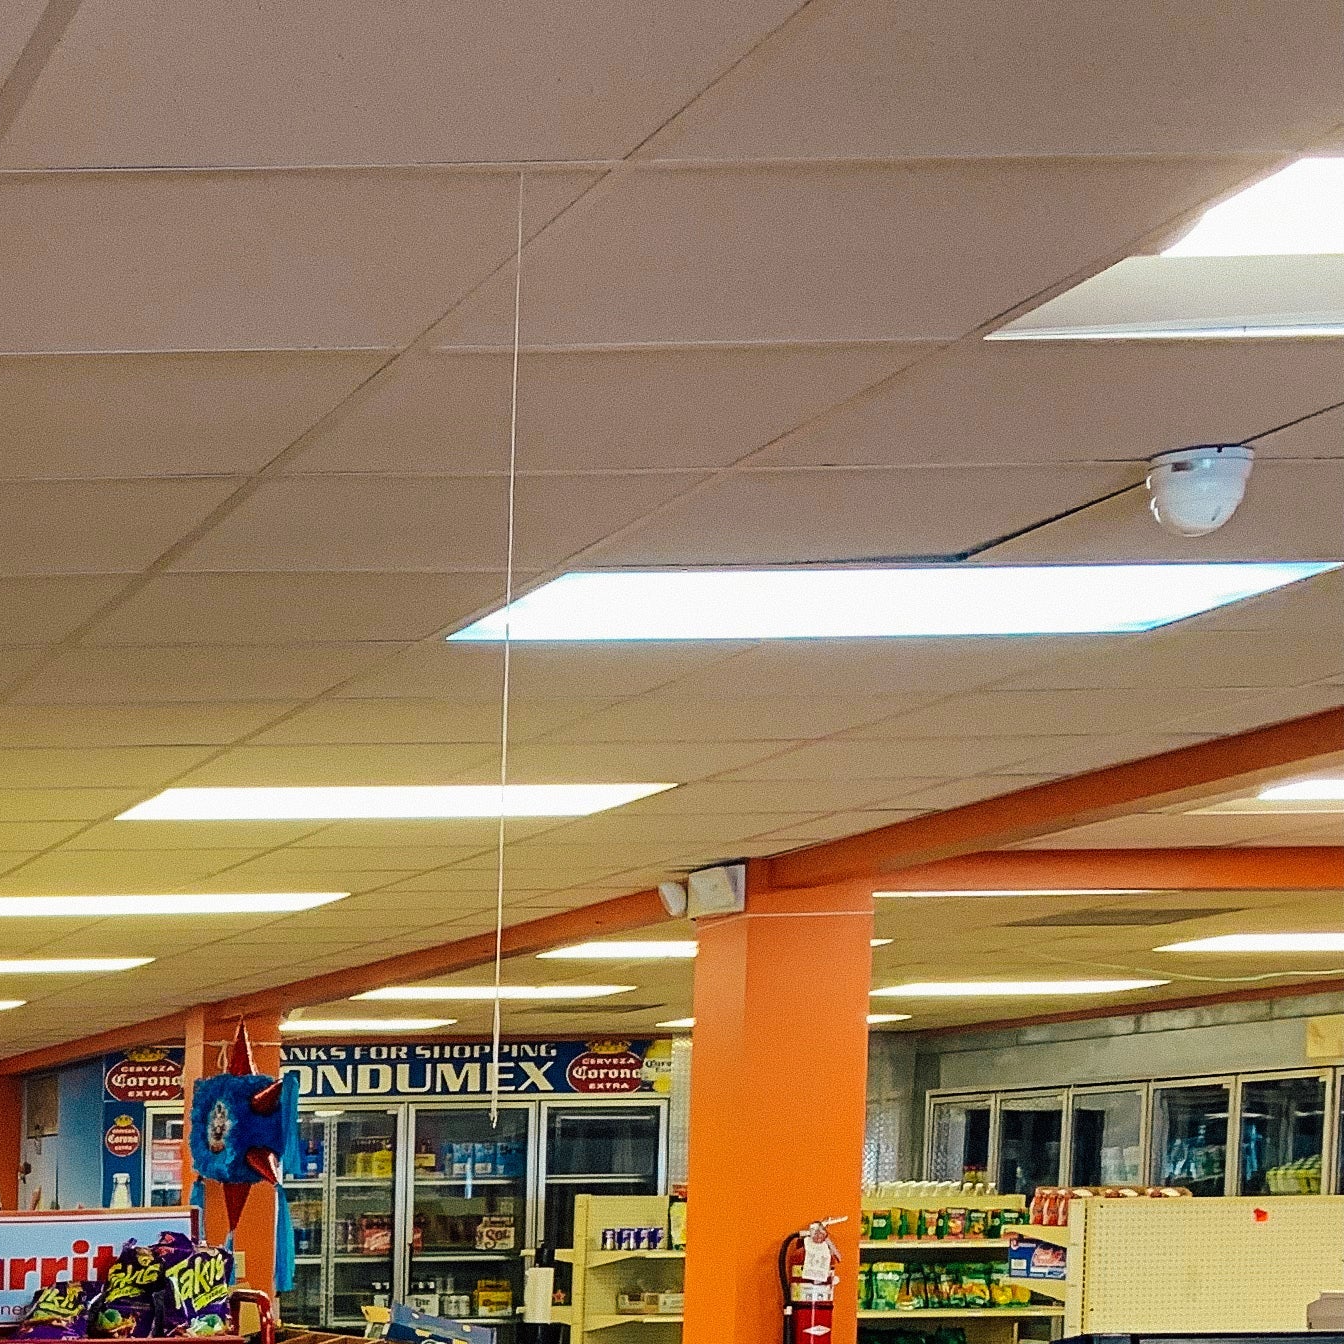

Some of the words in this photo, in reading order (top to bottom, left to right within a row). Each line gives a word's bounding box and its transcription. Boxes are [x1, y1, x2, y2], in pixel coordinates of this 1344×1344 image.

[355, 1046, 408, 1060] FOR
[415, 1044, 556, 1059] SHOPPING
[165, 1254, 225, 1310] Takis
